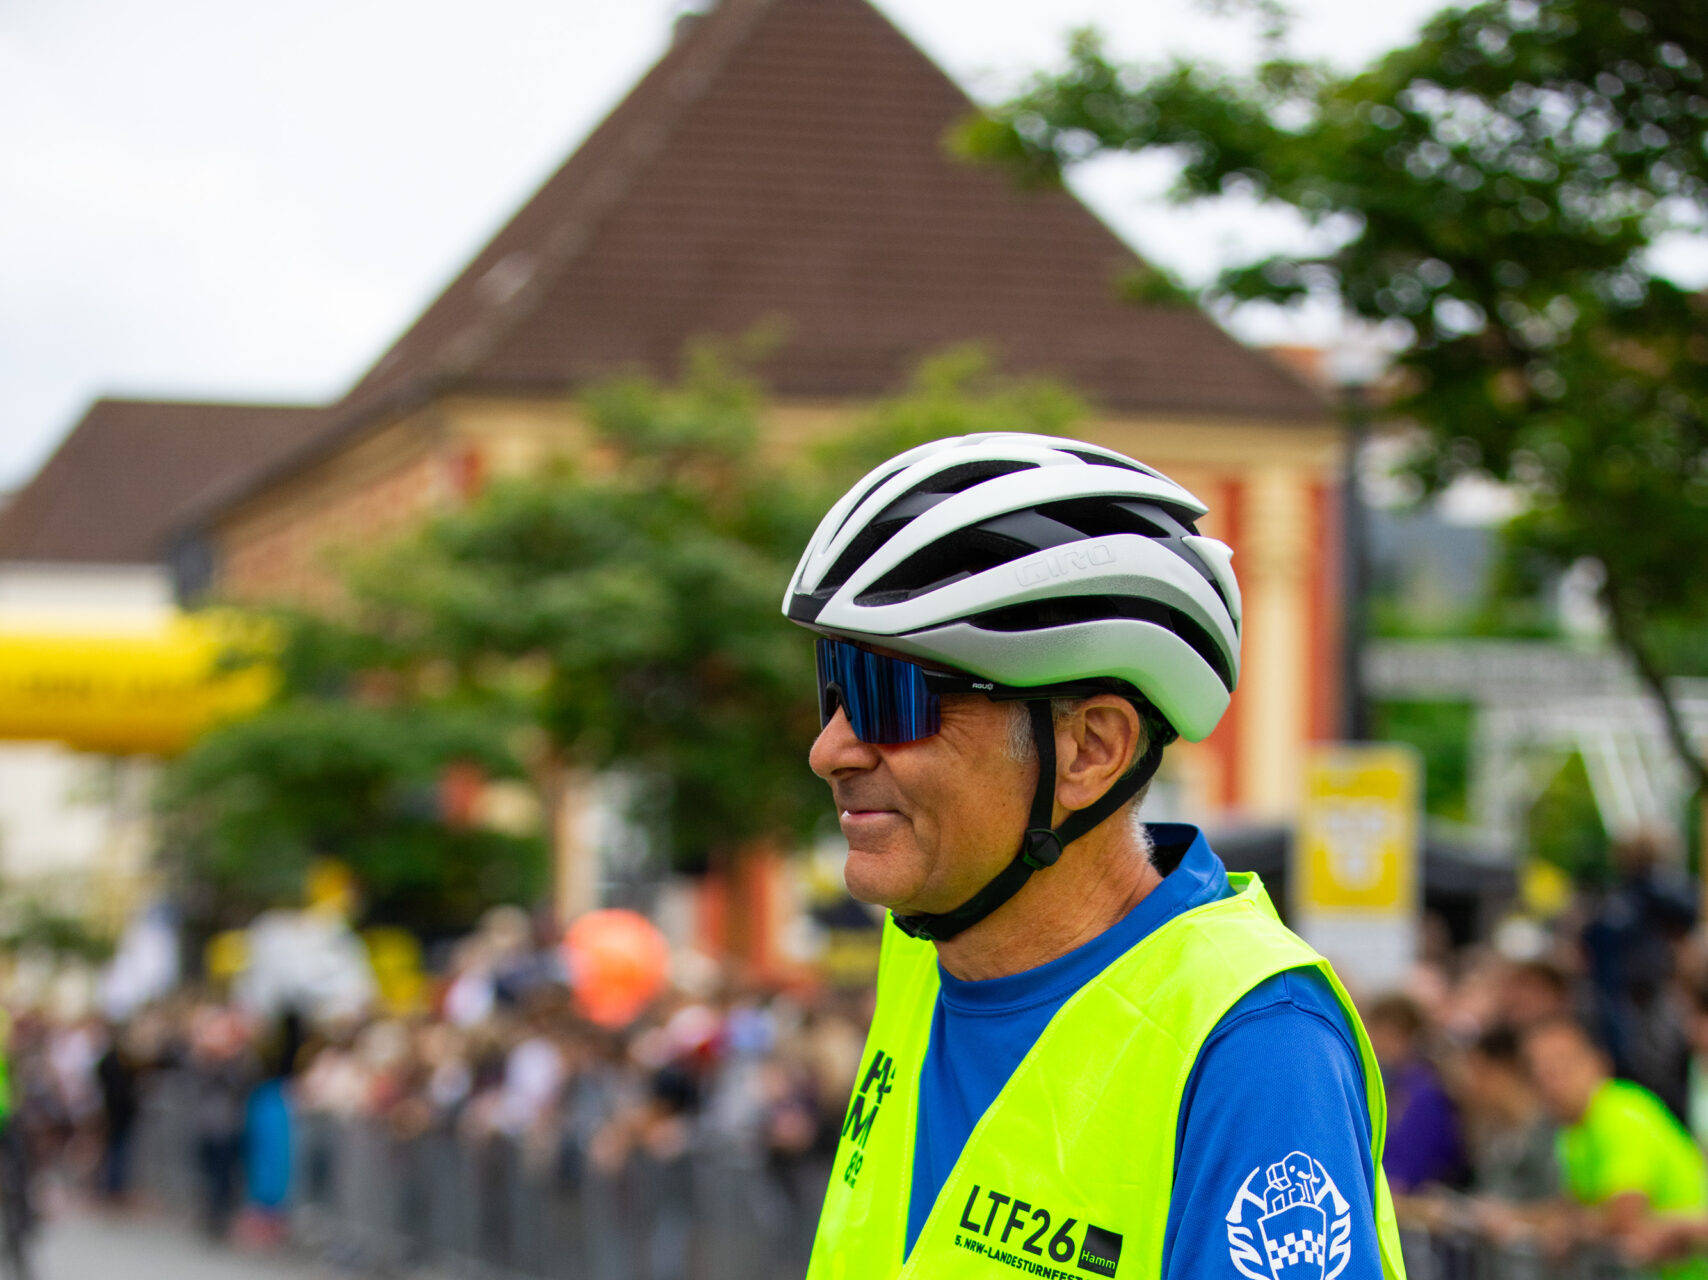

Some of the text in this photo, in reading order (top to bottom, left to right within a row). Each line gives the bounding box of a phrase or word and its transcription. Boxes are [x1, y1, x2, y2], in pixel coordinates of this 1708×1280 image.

[1015, 544, 1116, 587] GIRO
[960, 1184, 1078, 1263] LTF26
[954, 1234, 963, 1248] 5.
[1081, 1249, 1116, 1270] Hamm
